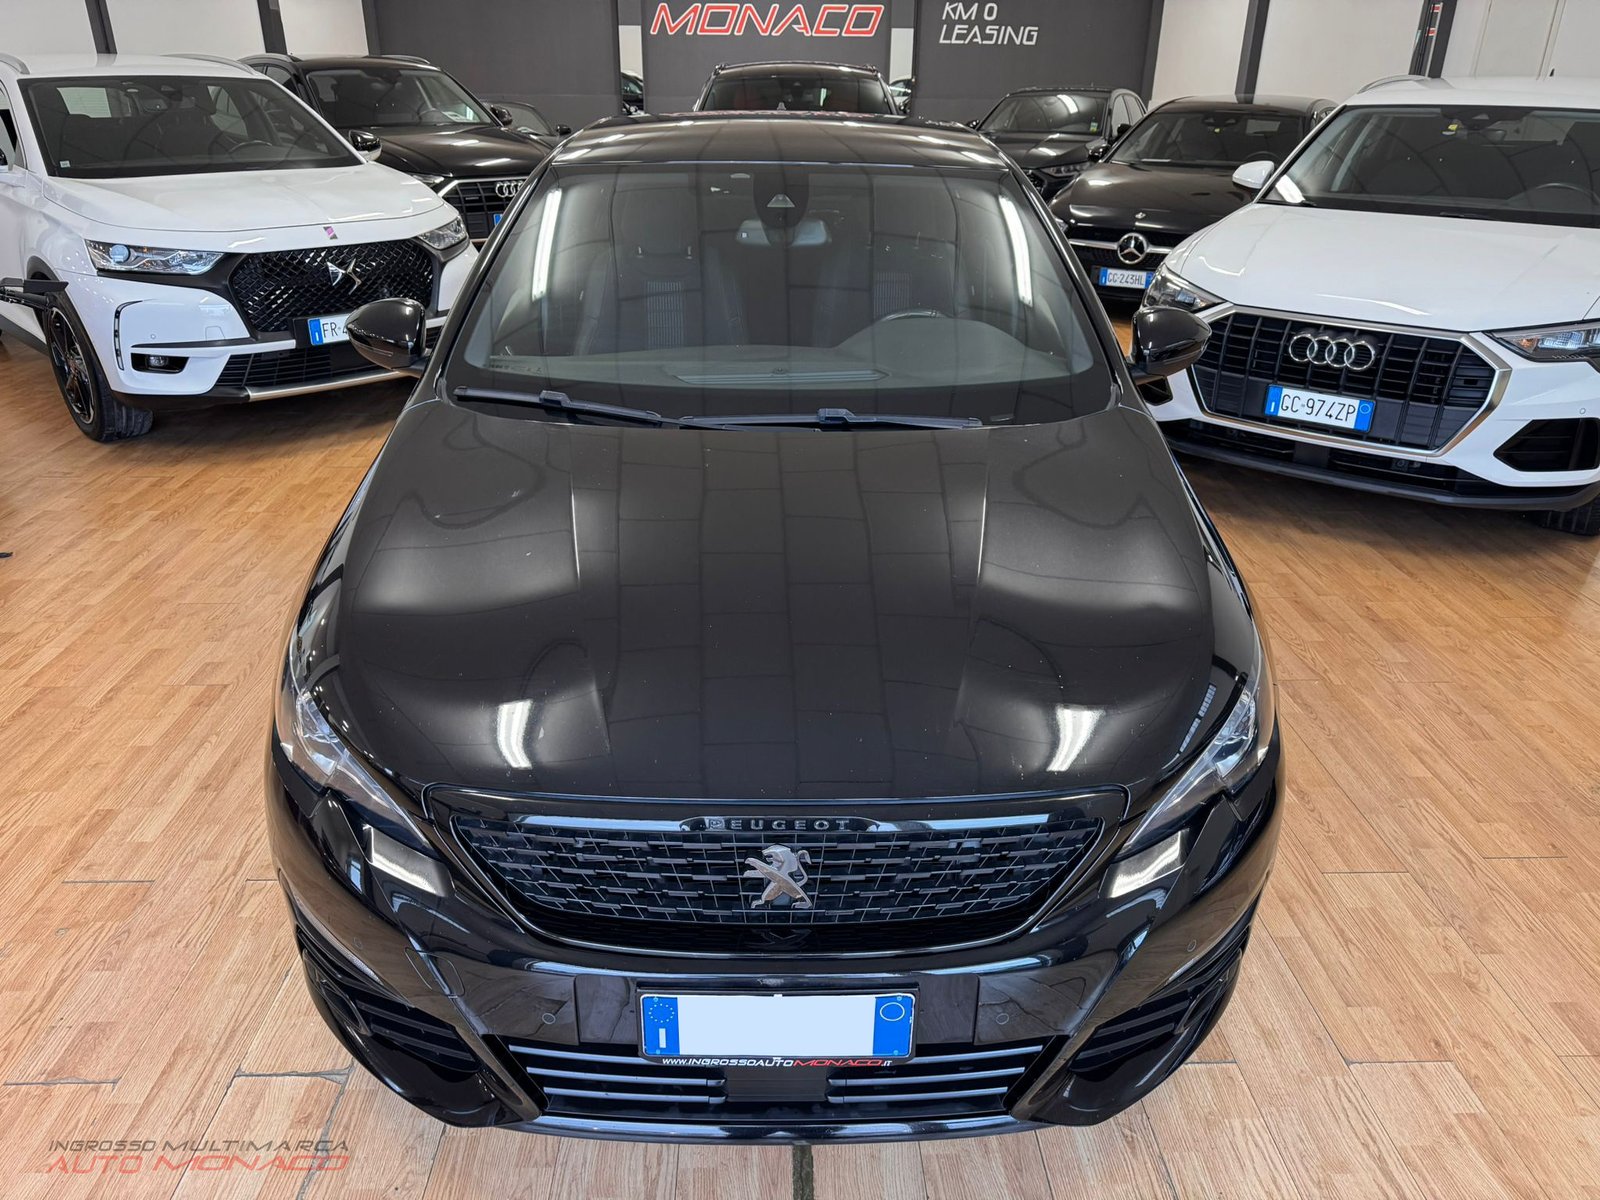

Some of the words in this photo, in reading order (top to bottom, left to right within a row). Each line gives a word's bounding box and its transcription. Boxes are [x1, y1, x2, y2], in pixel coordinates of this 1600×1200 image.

[650, 3, 884, 37] MONACO
[942, 2, 976, 20] KM
[939, 25, 1038, 45] LEASING
[708, 819, 849, 830] PEUGEOT
